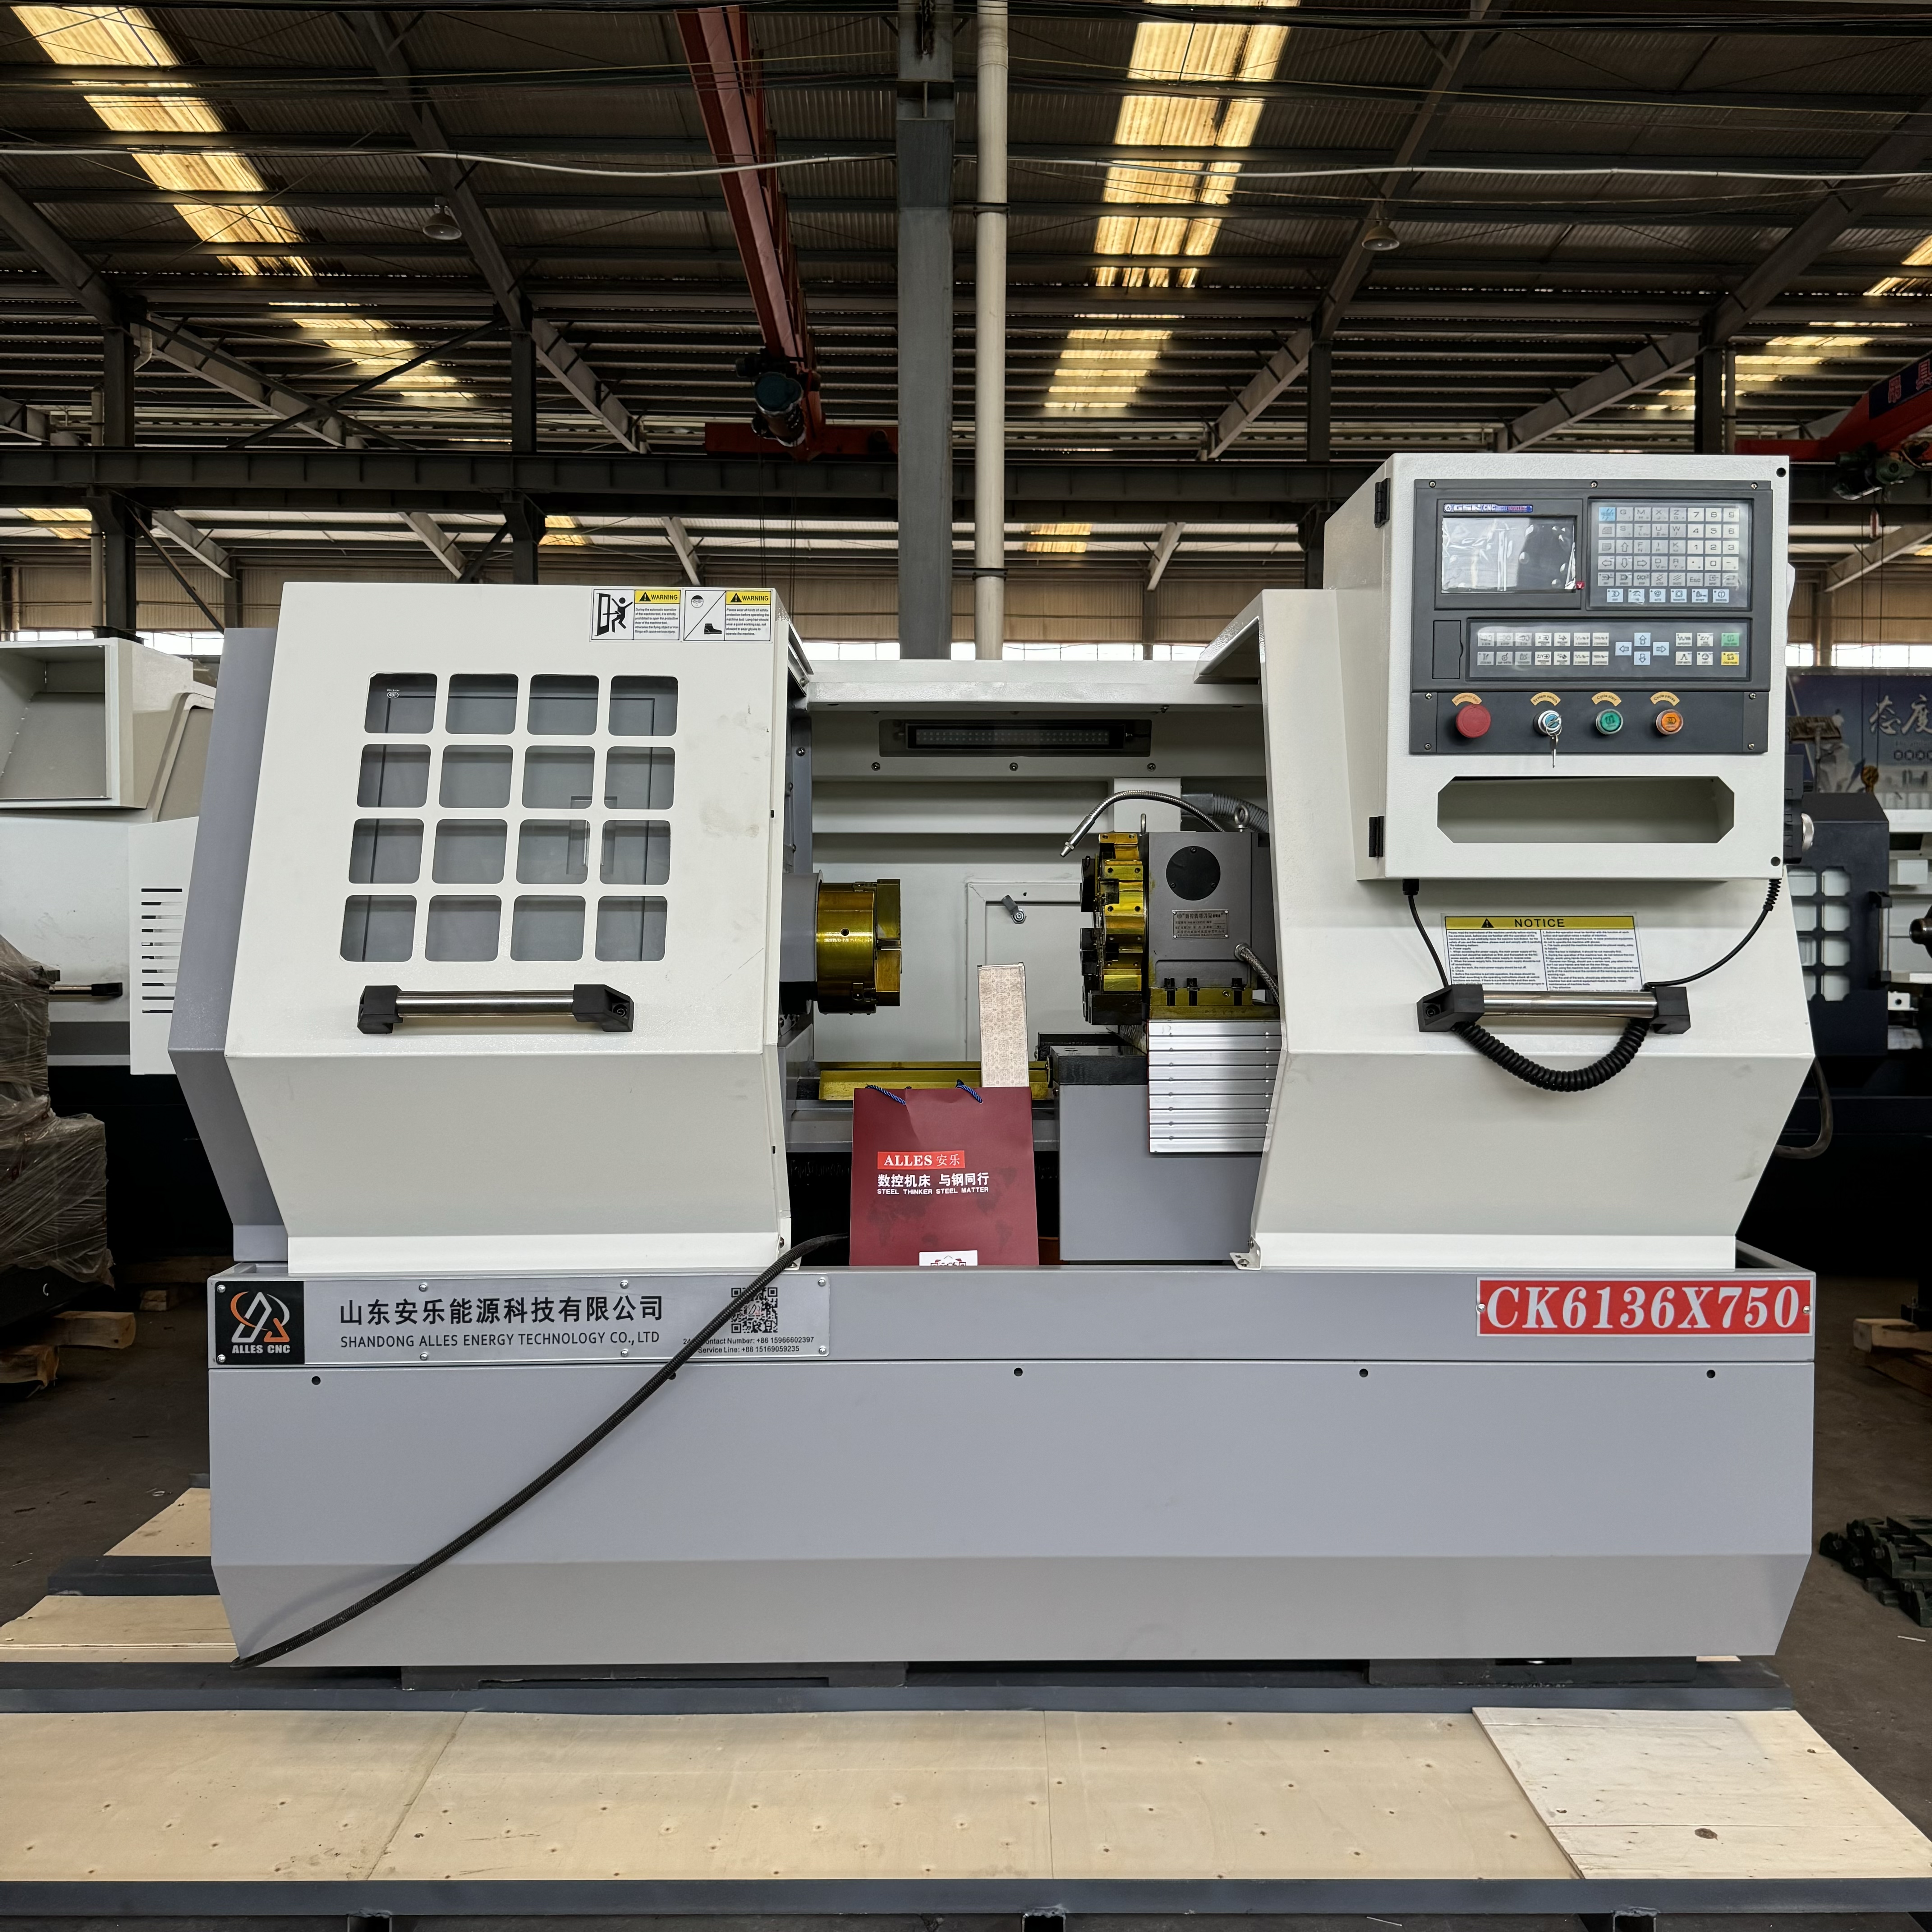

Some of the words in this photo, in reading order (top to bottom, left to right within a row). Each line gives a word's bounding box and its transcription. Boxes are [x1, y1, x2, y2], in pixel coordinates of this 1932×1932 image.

[1515, 919, 1565, 927] NOTICE
[883, 1155, 933, 1166] ALLES
[936, 1154, 960, 1167] 安乐
[878, 1173, 931, 1187] 数控机床
[938, 1172, 989, 1187] 与钢同行
[340, 1295, 662, 1325] 山东安乐能源科技有限公司
[1487, 1286, 1799, 1329] CK6136X750
[341, 1335, 414, 1348] SHANDONG
[419, 1335, 458, 1347] ALLES
[464, 1334, 513, 1346] ENERGY
[518, 1332, 605, 1345] TECHNOLOGY
[232, 1345, 263, 1353] ALLES
[267, 1344, 290, 1353] CNC
